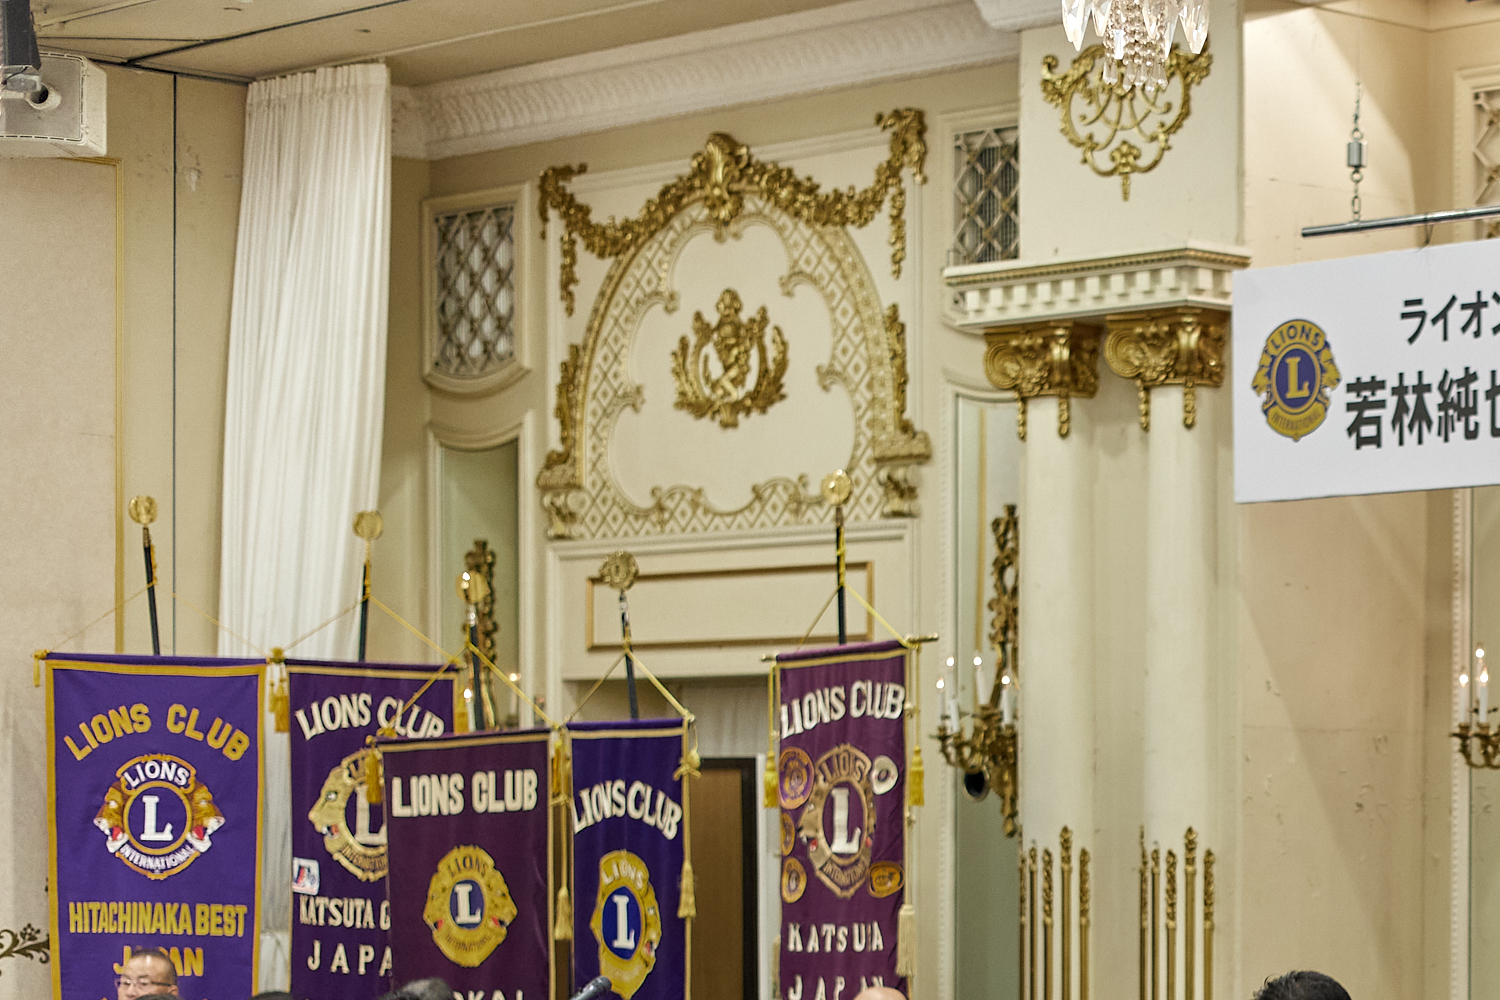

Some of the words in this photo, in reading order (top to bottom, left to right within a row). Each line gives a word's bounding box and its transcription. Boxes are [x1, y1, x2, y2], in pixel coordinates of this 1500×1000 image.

[1270, 324, 1322, 349] LIONS
[1285, 357, 1310, 399] L
[295, 692, 372, 741] LIONS
[780, 685, 846, 740] LIONS
[850, 680, 906, 720] CLUB
[63, 702, 152, 762] LIONS
[166, 703, 250, 762] CLUB
[123, 760, 190, 788] LIONS
[391, 772, 465, 818] LIONS
[471, 768, 538, 814] CLUB
[140, 795, 173, 841] L
[831, 787, 862, 854] L
[119, 843, 196, 871] INTERNATIONAL
[447, 855, 488, 878] LIONS
[602, 858, 645, 890] LIONS
[69, 901, 193, 936] HITACHINAKA
[194, 904, 248, 938] BEST
[299, 895, 376, 929] KATSUTA
[453, 883, 481, 925] L
[613, 894, 636, 950] L
[113, 945, 204, 977] JAN
